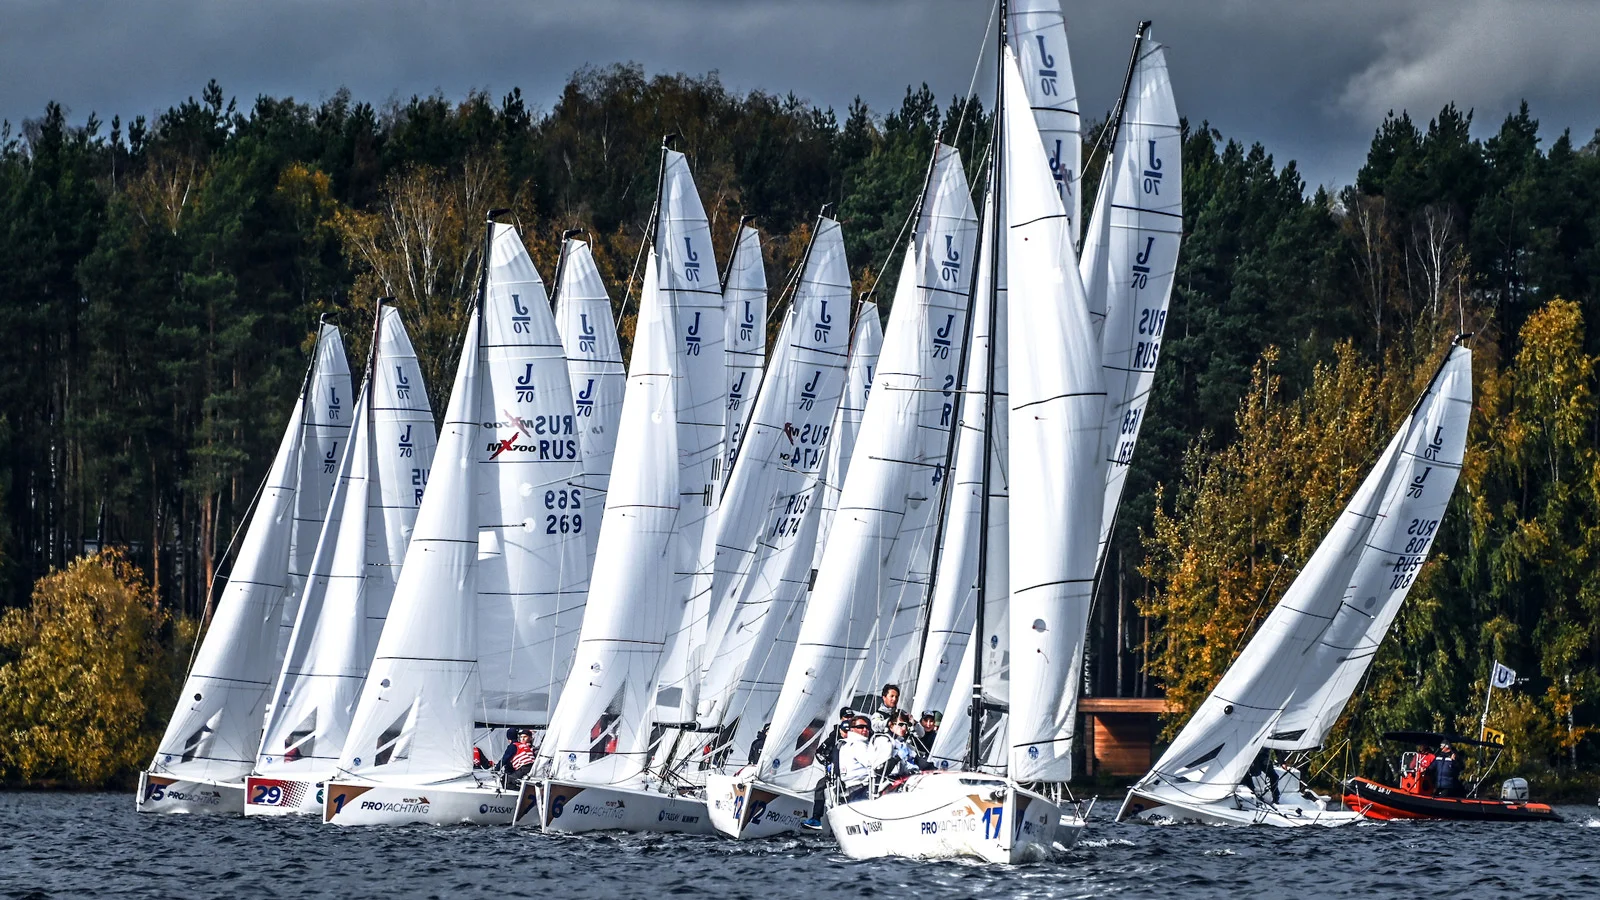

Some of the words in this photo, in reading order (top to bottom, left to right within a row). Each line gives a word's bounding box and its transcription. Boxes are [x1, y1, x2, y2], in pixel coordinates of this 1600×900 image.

[1136, 237, 1154, 265] J
[1131, 273, 1147, 290] 70
[688, 312, 701, 335] J
[937, 314, 954, 338] J
[686, 343, 700, 356] 70
[933, 345, 949, 360] 70
[1132, 341, 1158, 369] RUS
[517, 364, 533, 385] J
[732, 372, 746, 392] J
[805, 371, 821, 392] J
[517, 392, 534, 403] 70
[579, 379, 594, 400] J
[577, 406, 592, 417] 70
[728, 399, 740, 411] 70
[799, 398, 814, 411] 70
[400, 425, 412, 442] J
[327, 442, 338, 459] J
[400, 448, 412, 458] 70
[539, 440, 576, 460] RUS
[324, 464, 335, 474] 70
[1415, 467, 1432, 484] J
[1406, 487, 1423, 499] 70
[785, 494, 810, 514] RUS
[546, 514, 582, 535] 269
[772, 517, 801, 538] 1474
[1393, 556, 1421, 573] RUS
[1389, 573, 1413, 590] 108
[1498, 669, 1508, 684] U
[167, 791, 220, 805] PROYACHTING
[253, 785, 281, 804] 29
[333, 794, 346, 814] 1
[361, 801, 430, 814] PROYACHTING
[489, 806, 513, 814] TASSAY
[552, 795, 566, 818] 6
[573, 804, 624, 819] PROYACHTING
[733, 795, 744, 819] 12
[921, 818, 976, 834] PROYACHTING
[982, 807, 1003, 839] 17
